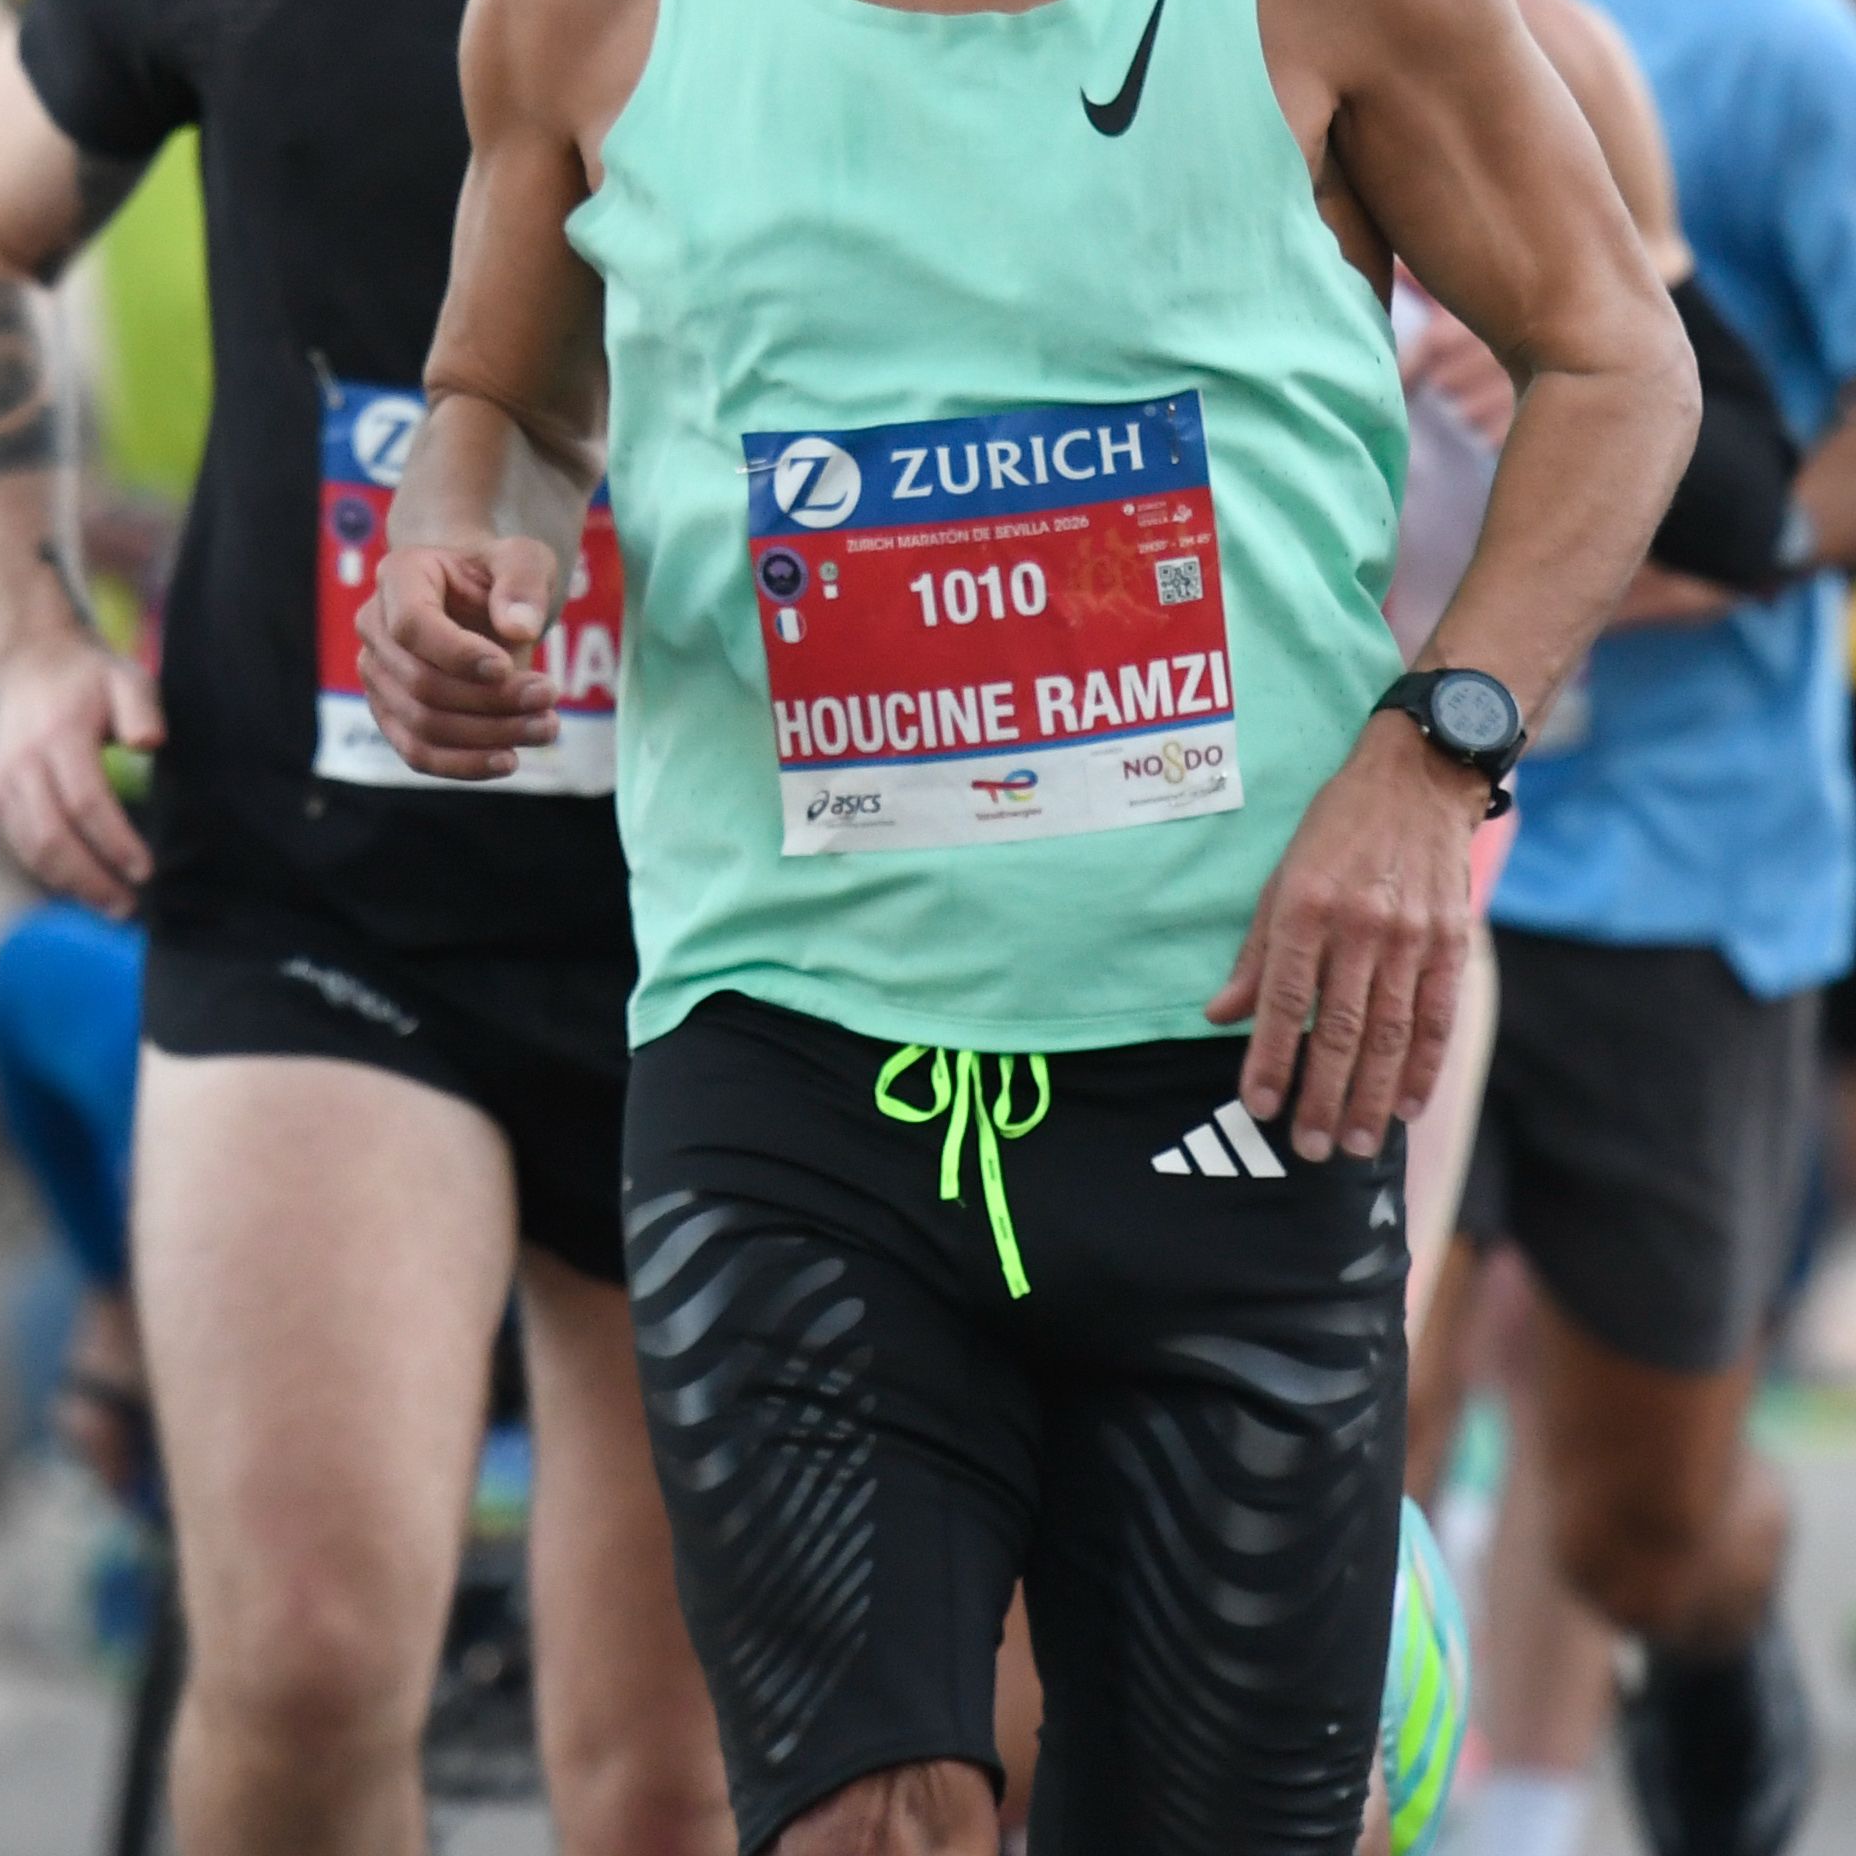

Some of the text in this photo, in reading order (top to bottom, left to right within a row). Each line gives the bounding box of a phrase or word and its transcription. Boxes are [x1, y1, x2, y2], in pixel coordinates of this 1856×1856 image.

[889, 422, 1144, 500] ZURICH
[847, 536, 893, 553] ZURICH
[994, 521, 1050, 540] SEVILLA
[909, 560, 1047, 627] 1010
[774, 649, 1230, 758] HOUCINE RAMZI
